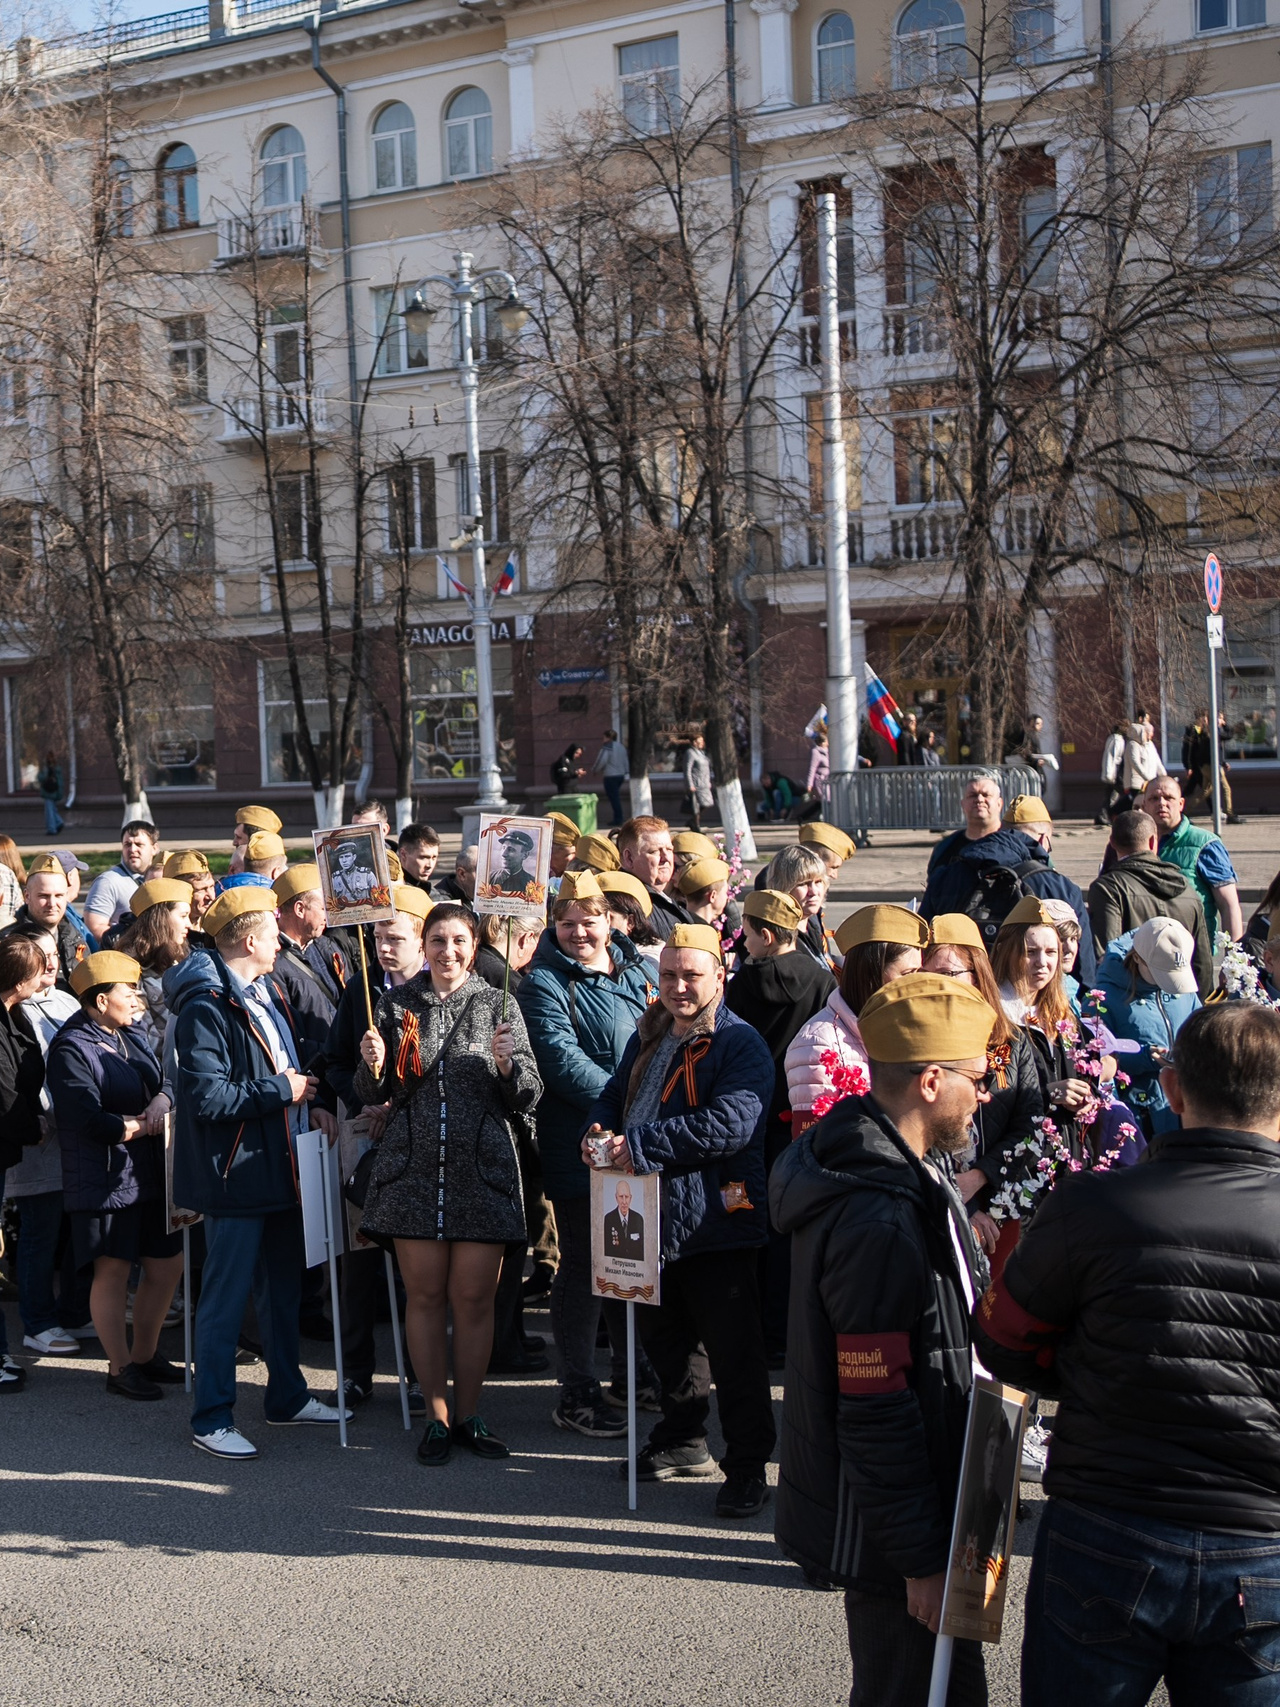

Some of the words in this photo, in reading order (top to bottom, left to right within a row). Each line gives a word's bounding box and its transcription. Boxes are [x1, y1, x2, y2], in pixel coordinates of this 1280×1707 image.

[405, 622, 510, 645] ANAGOIA
[611, 1258, 637, 1268] Петрушков
[604, 1266, 621, 1274] Михаил
[621, 1269, 645, 1278] Иванович
